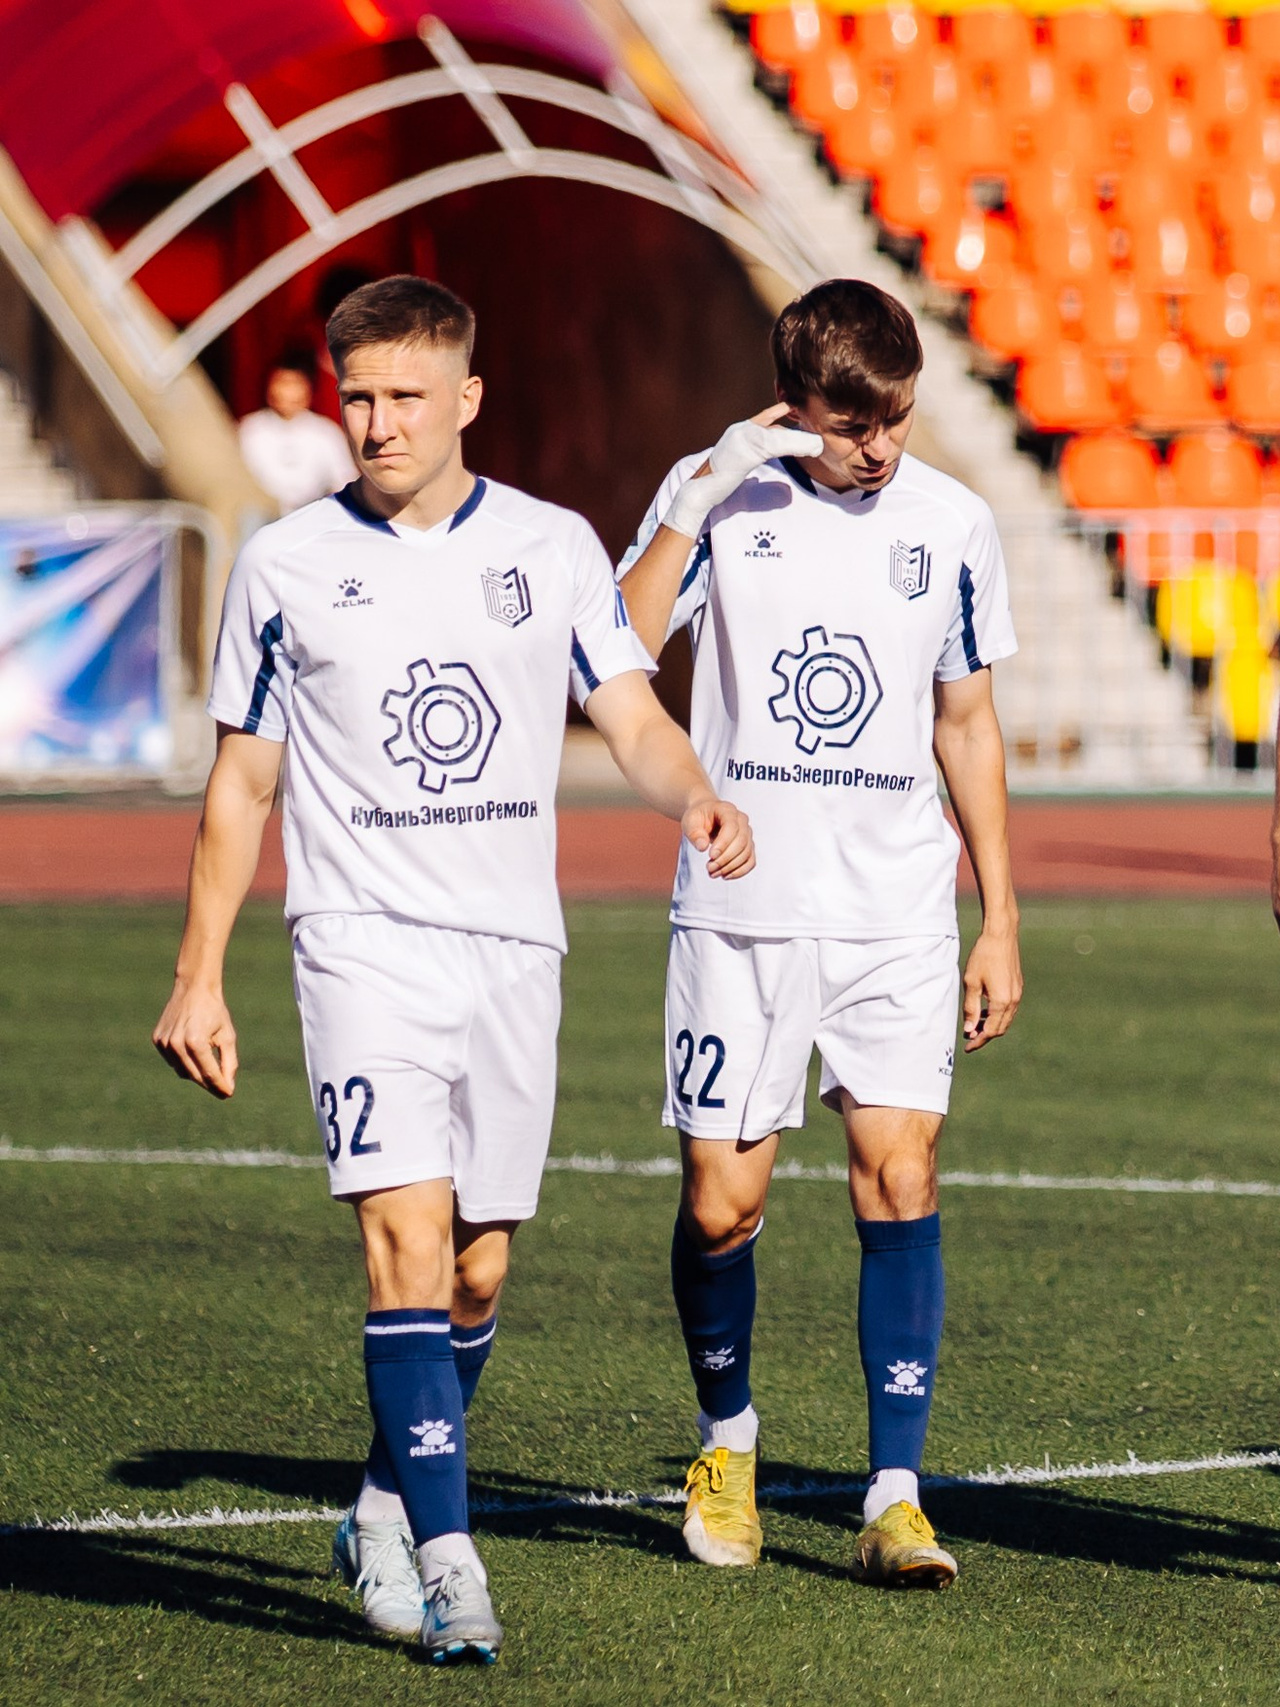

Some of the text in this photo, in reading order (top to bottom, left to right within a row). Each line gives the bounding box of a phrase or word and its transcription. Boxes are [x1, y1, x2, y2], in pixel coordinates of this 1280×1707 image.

[744, 550, 783, 558] KELME
[332, 597, 375, 609] KELME
[726, 758, 915, 792] КубаньЭнергоРемонт
[350, 800, 538, 829] КубаньЭнергоРемон
[675, 1028, 726, 1109] 22
[319, 1075, 382, 1163] 32
[884, 1383, 925, 1396] KELME
